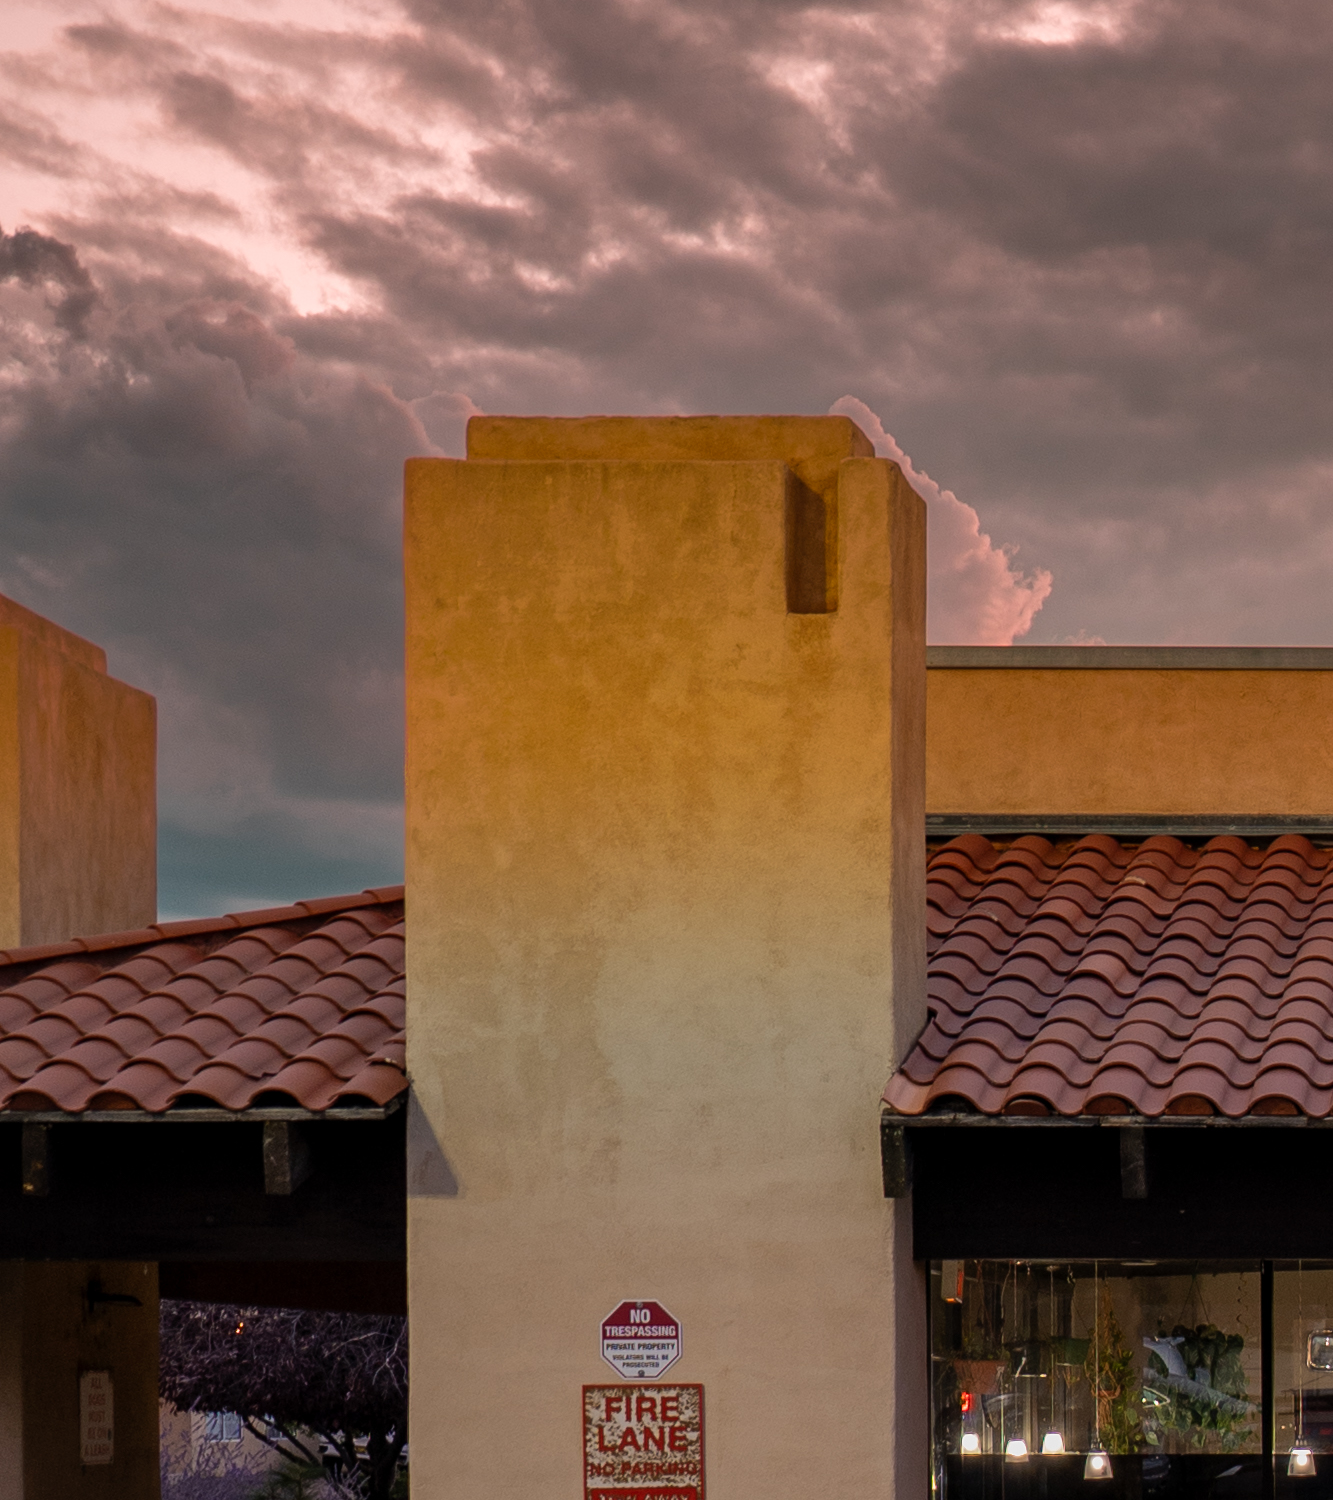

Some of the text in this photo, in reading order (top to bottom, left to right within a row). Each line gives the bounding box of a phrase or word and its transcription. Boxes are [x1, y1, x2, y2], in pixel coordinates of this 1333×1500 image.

[630, 1308, 651, 1324] NO
[604, 1325, 676, 1337] TRESPASSING
[605, 1396, 680, 1422] FIRE
[597, 1426, 688, 1451] LANE
[588, 1462, 697, 1476] NO PARKING
